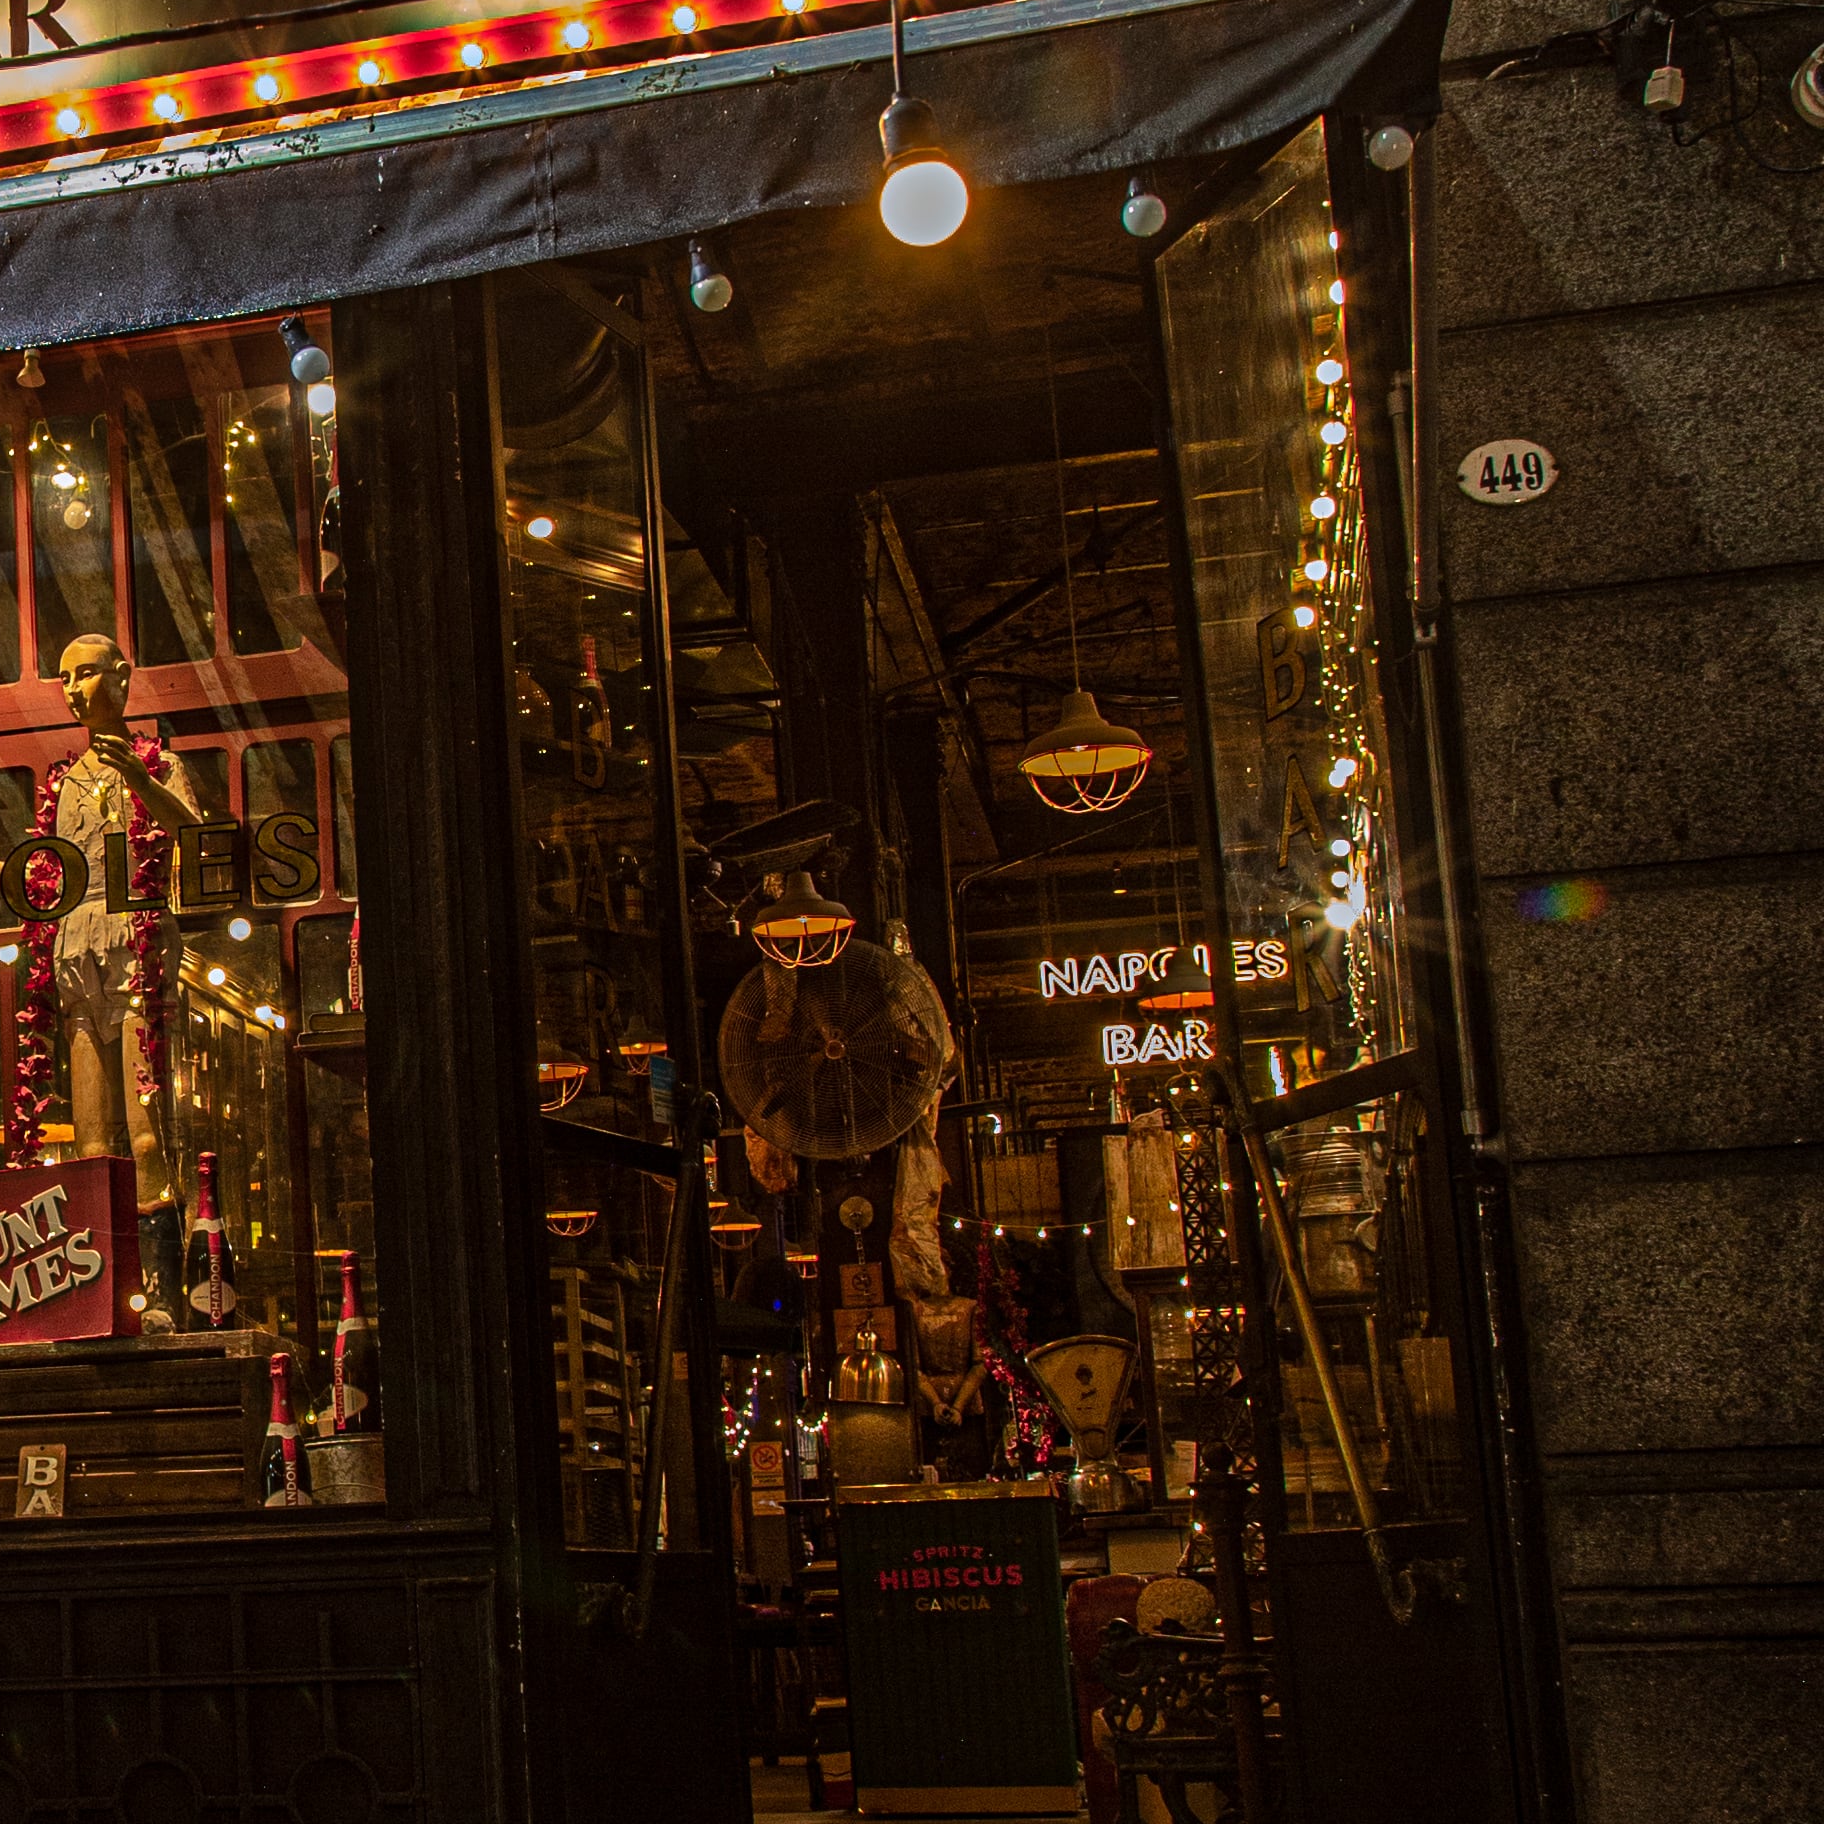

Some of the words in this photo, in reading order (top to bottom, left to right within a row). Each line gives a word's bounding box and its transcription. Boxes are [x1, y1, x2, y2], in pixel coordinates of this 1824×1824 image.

[1479, 452, 1543, 495] 449
[1254, 604, 1342, 1014] BAR
[350, 939, 359, 1006] CHANDON
[1102, 1019, 1216, 1065] BAR
[210, 1254, 222, 1320] CHANDON
[334, 1357, 345, 1425] CHANDON
[285, 1460, 297, 1506] NDON
[911, 1544, 985, 1564] SPRITZ
[878, 1563, 1025, 1592] HIBISCUS
[914, 1594, 992, 1613] GANCIA
